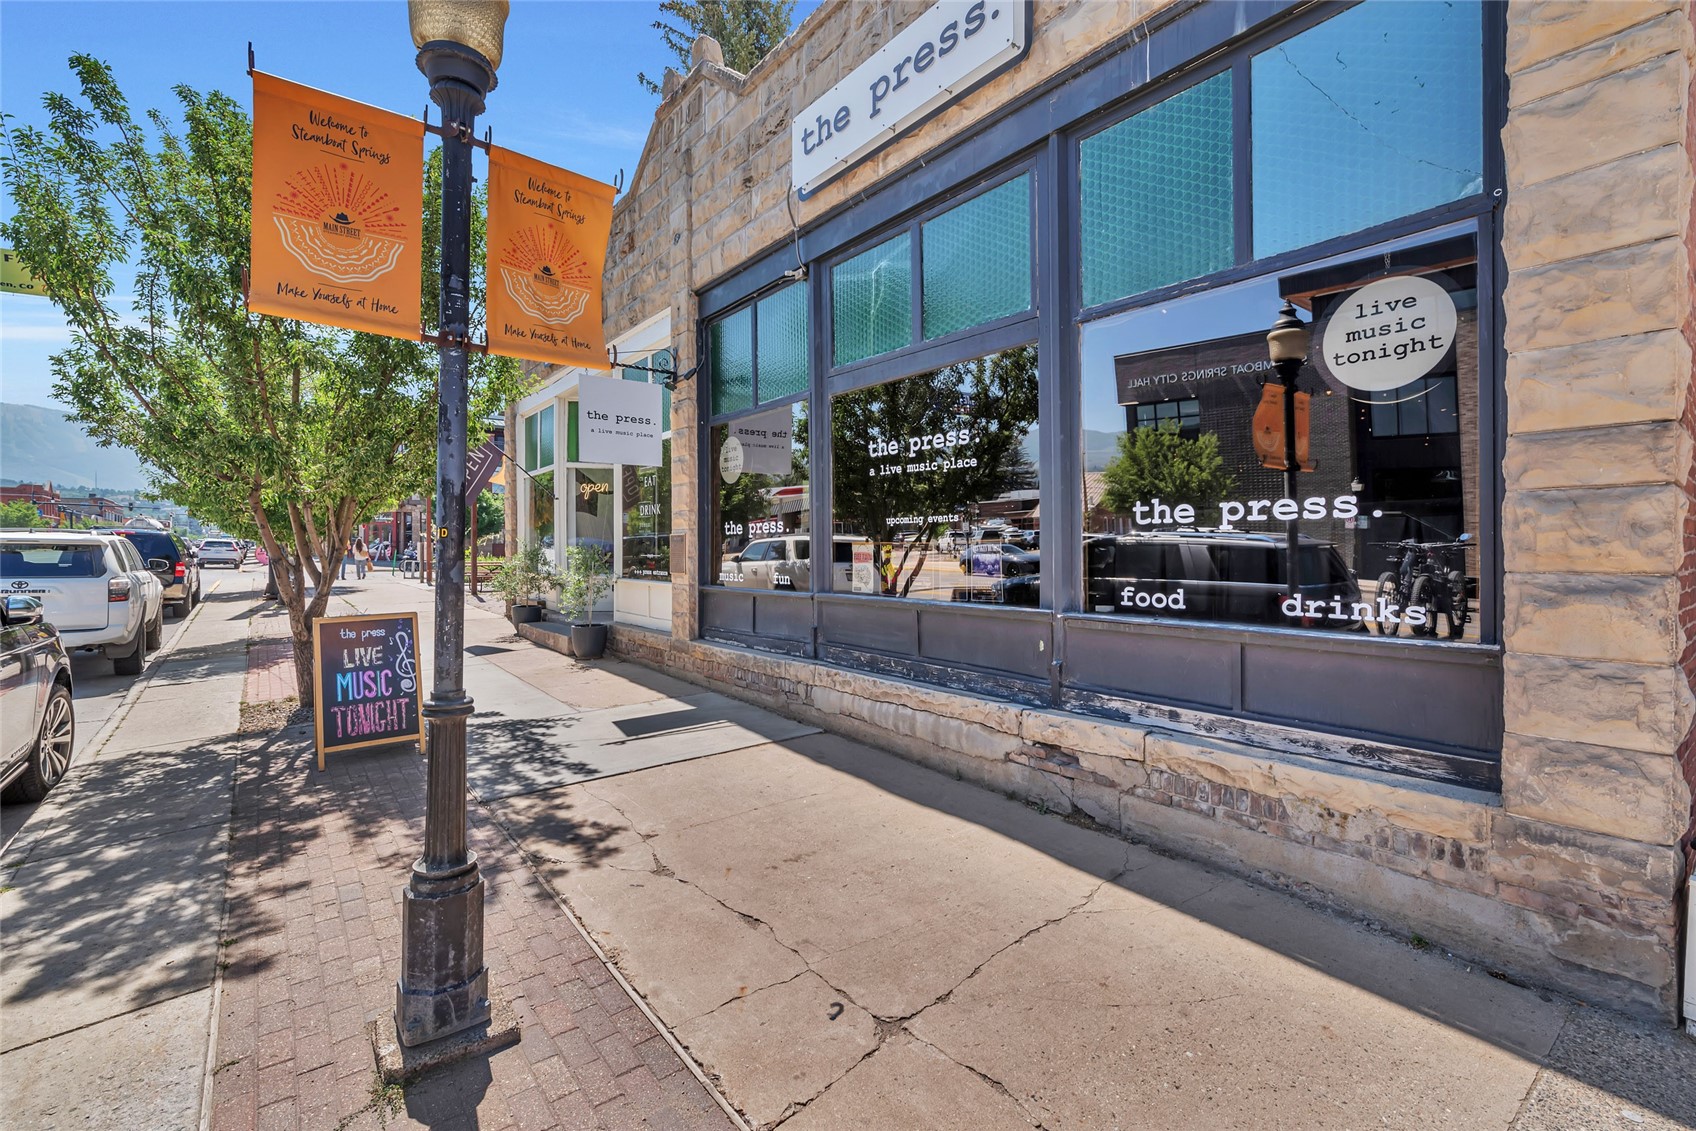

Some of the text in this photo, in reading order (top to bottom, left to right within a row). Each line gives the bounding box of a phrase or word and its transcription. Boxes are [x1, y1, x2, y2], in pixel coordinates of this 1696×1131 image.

[801, 0, 1000, 156] the press.
[309, 109, 369, 139] Welcome to
[291, 123, 391, 166] Steamboat Springs
[527, 176, 572, 203] Welcome to
[514, 188, 586, 225] Steamboat Springs
[322, 221, 338, 233] MAIN
[339, 225, 361, 238] STREET
[276, 281, 399, 315] Make Yourself at Home
[1355, 296, 1417, 319] live
[504, 323, 592, 350] Make Yourself at Home
[1345, 317, 1426, 343] music
[1333, 335, 1444, 366] tonight
[587, 410, 657, 426] the press.
[868, 429, 980, 457] the press.
[869, 457, 977, 476] a live music place
[580, 482, 609, 500] open
[644, 475, 657, 487] EAT
[640, 503, 661, 516] DRINK
[886, 513, 959, 526] upcoming events
[1132, 495, 1383, 530] the press.
[724, 520, 790, 538] the press.
[719, 571, 744, 582] music
[773, 572, 790, 585] fun
[1120, 587, 1186, 610] food
[1281, 594, 1427, 625] drinks
[340, 628, 386, 641] the press
[343, 645, 383, 669] LIVE
[336, 669, 392, 702] MUSIC
[330, 697, 410, 738] TONIGHT
